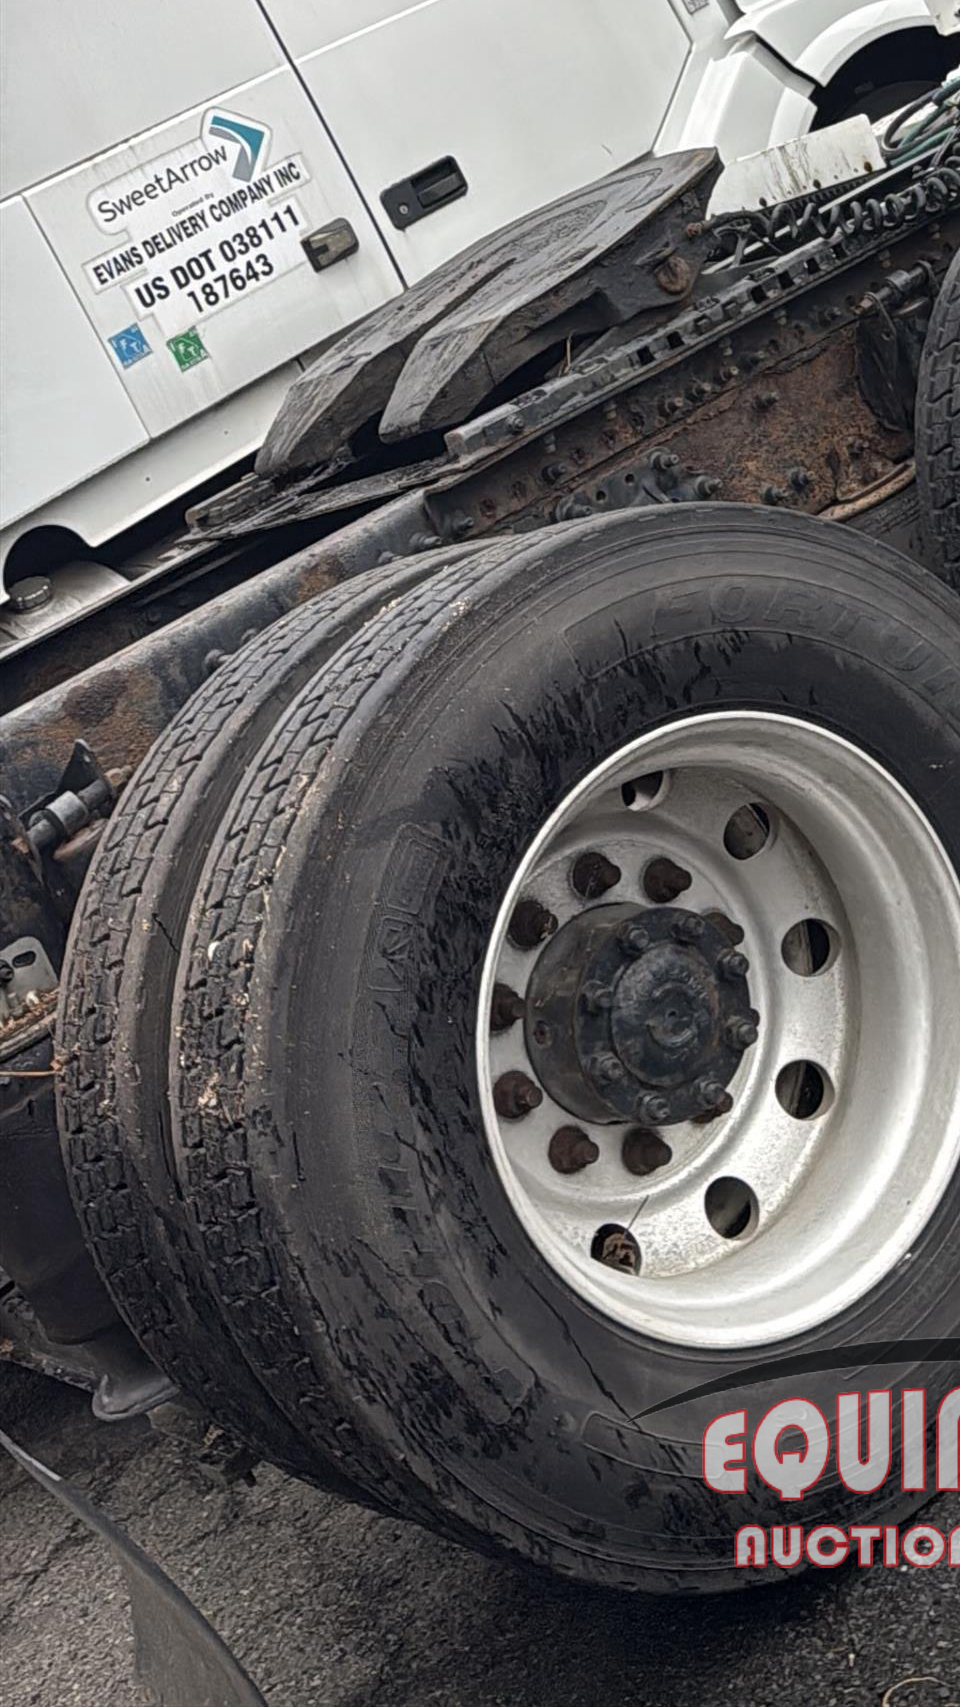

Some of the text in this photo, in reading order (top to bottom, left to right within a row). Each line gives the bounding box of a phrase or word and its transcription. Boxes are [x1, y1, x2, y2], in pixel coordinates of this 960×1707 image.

[93, 162, 301, 284] EVANS DELIVERY COMPANY INC
[97, 146, 228, 222] SweetArrow
[135, 204, 300, 308] US DOT 038111
[187, 253, 275, 313] 187643
